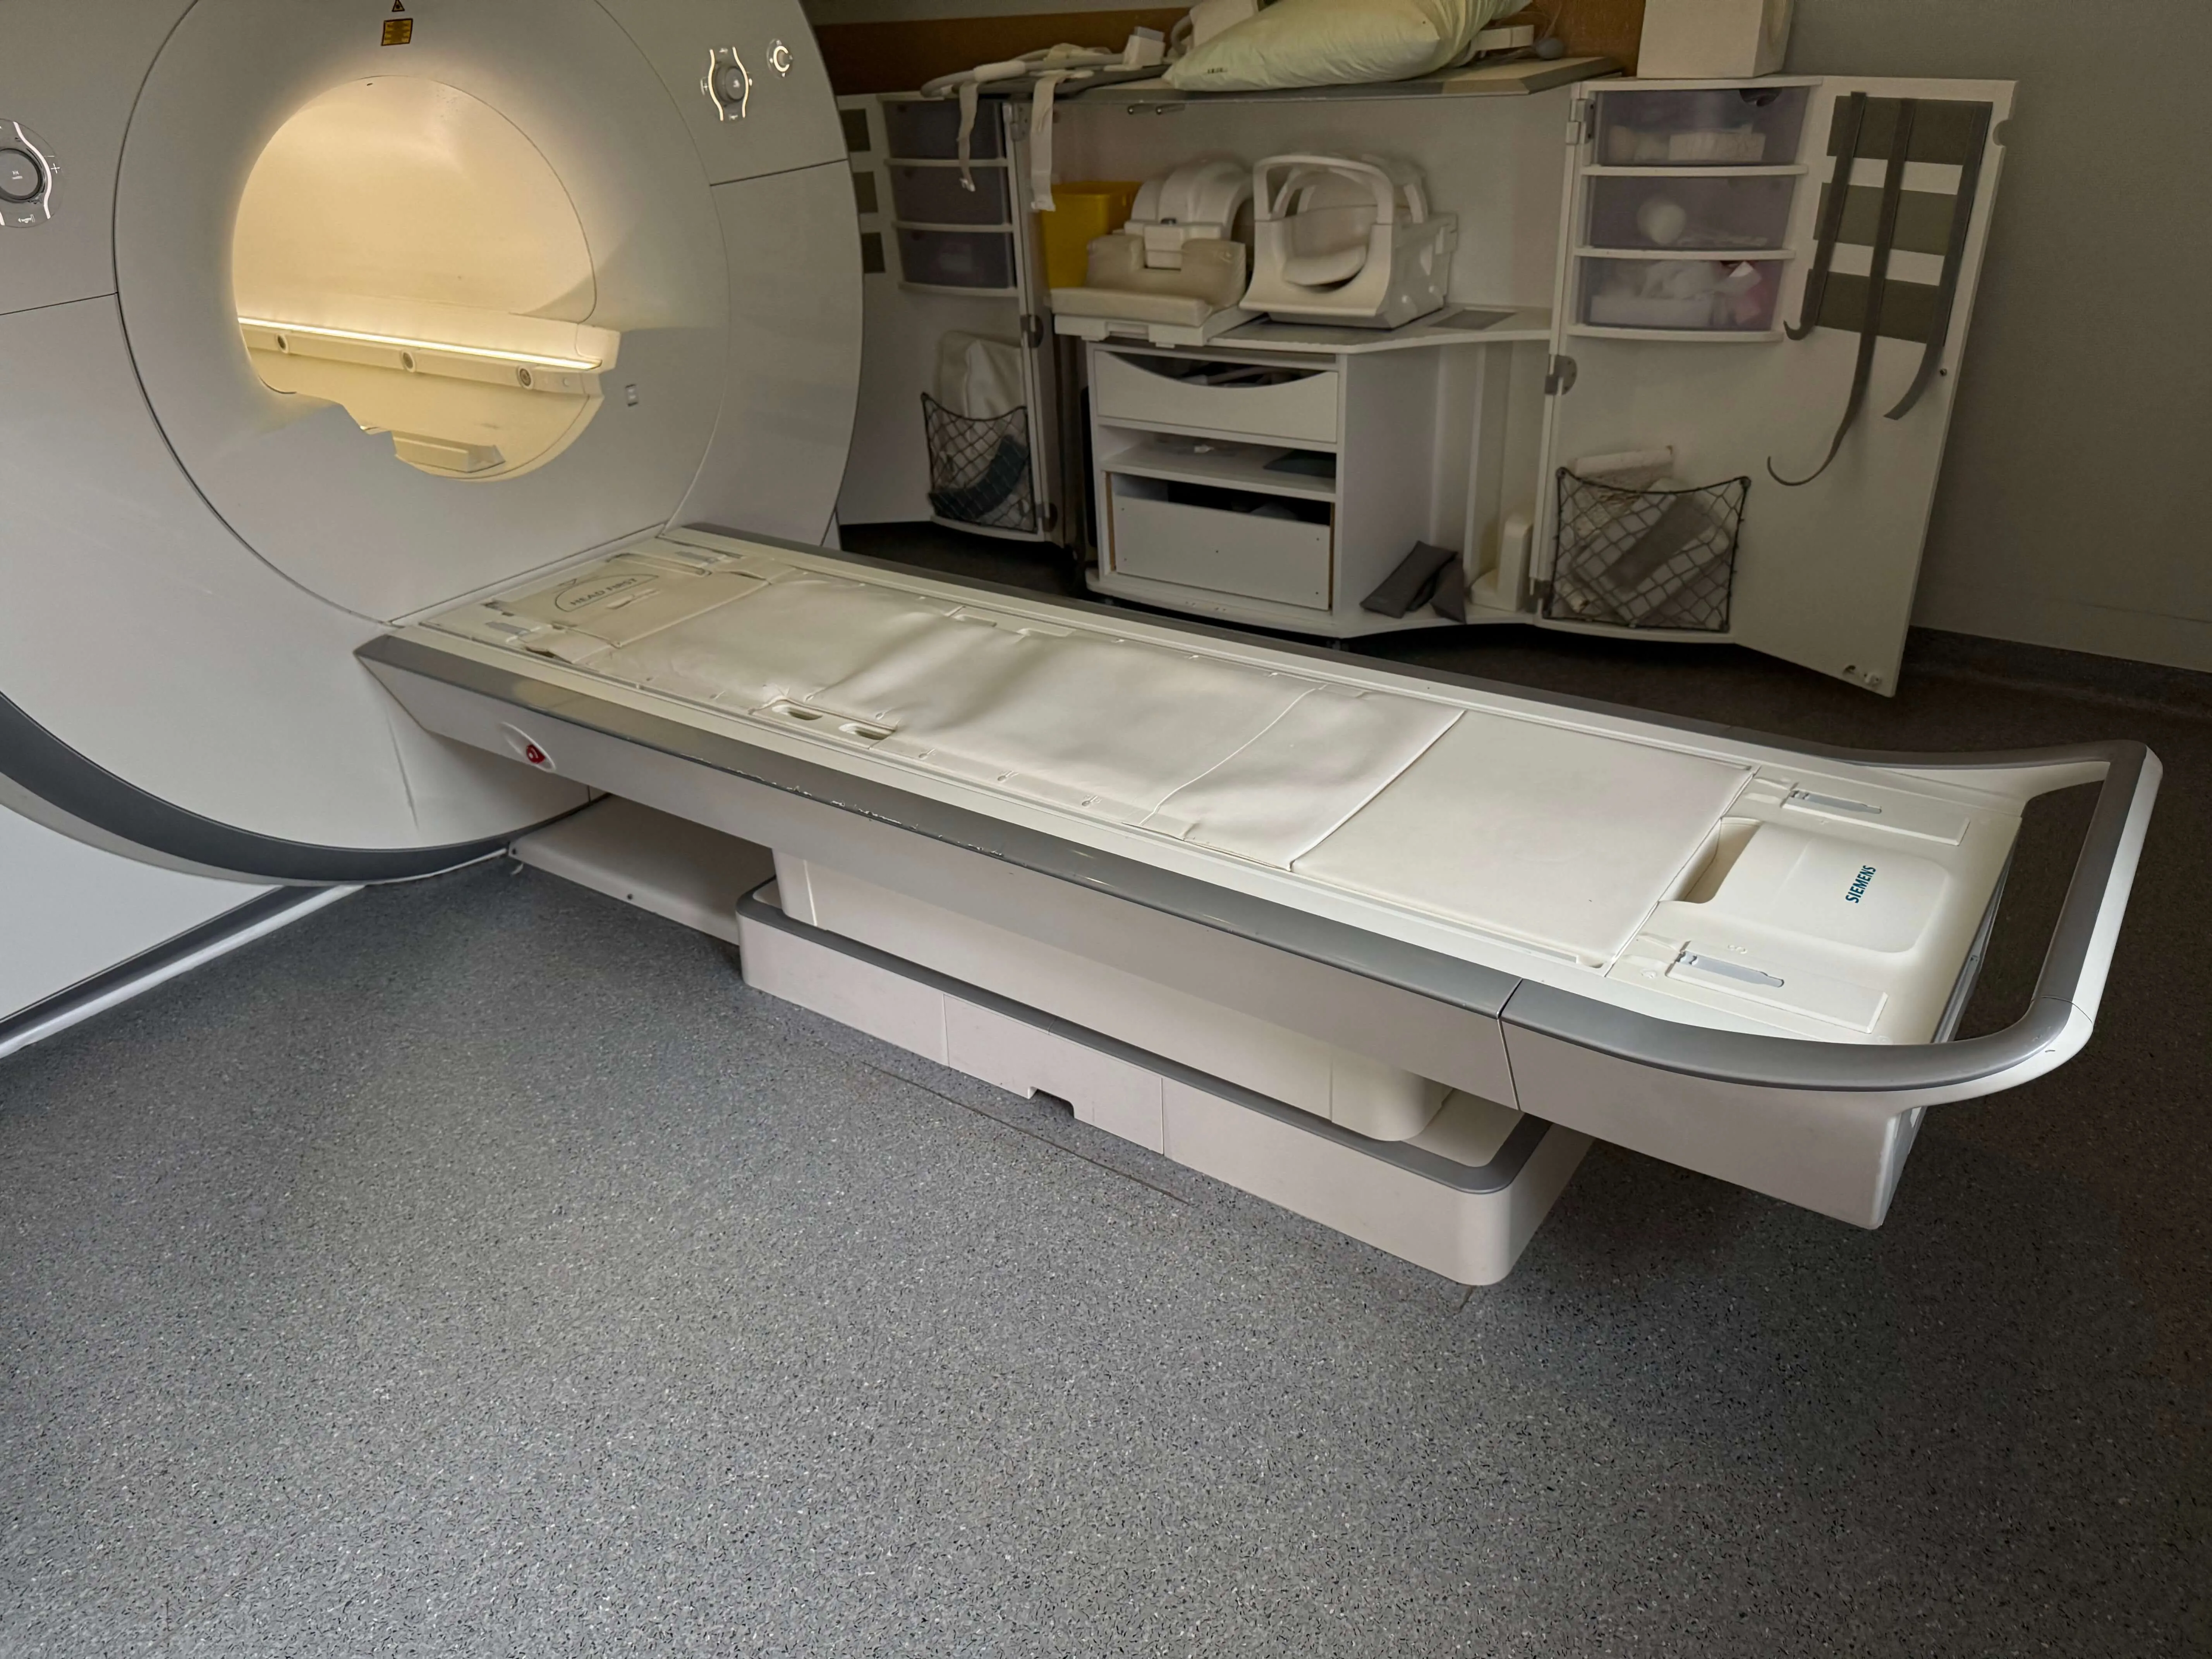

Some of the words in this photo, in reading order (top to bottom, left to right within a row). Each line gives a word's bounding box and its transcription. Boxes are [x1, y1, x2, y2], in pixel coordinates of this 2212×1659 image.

[570, 590, 605, 606] HEAD
[606, 578, 637, 591] FIRST
[1845, 865, 1876, 903] SIEMENS
